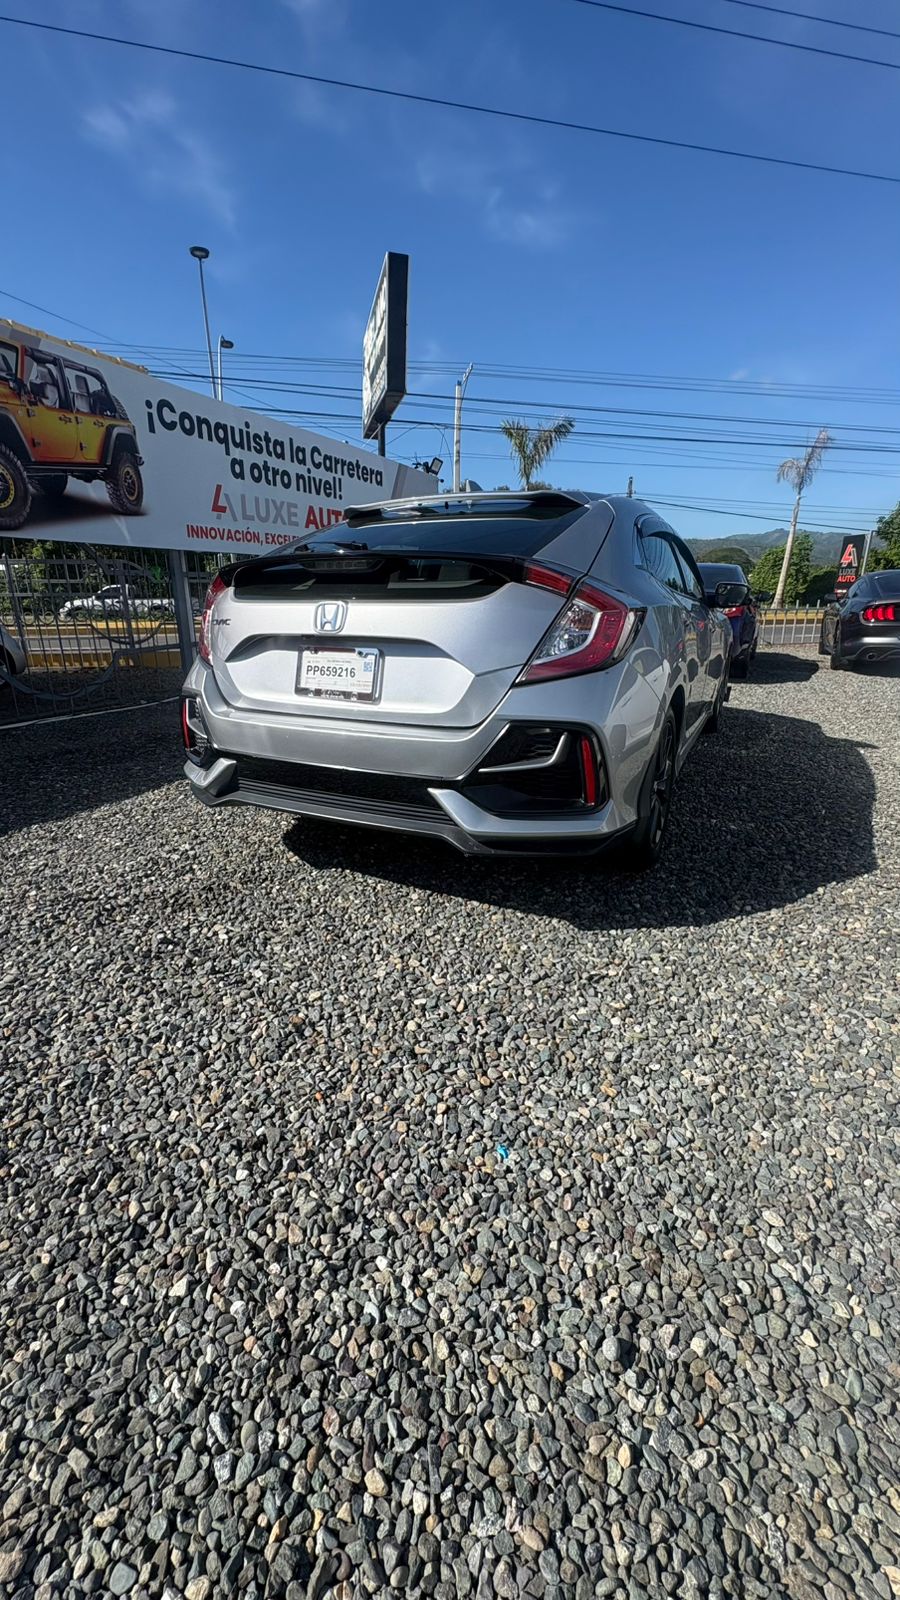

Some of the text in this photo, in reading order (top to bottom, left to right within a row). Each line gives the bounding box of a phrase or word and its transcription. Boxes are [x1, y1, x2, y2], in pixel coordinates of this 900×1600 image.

[144, 398, 383, 487] ¡Conquista la Carretera
[230, 456, 343, 501] a otro nivel!
[241, 493, 299, 527] LUXE
[186, 524, 264, 546] INNOVACIÓN,
[306, 665, 356, 678] PP659216
